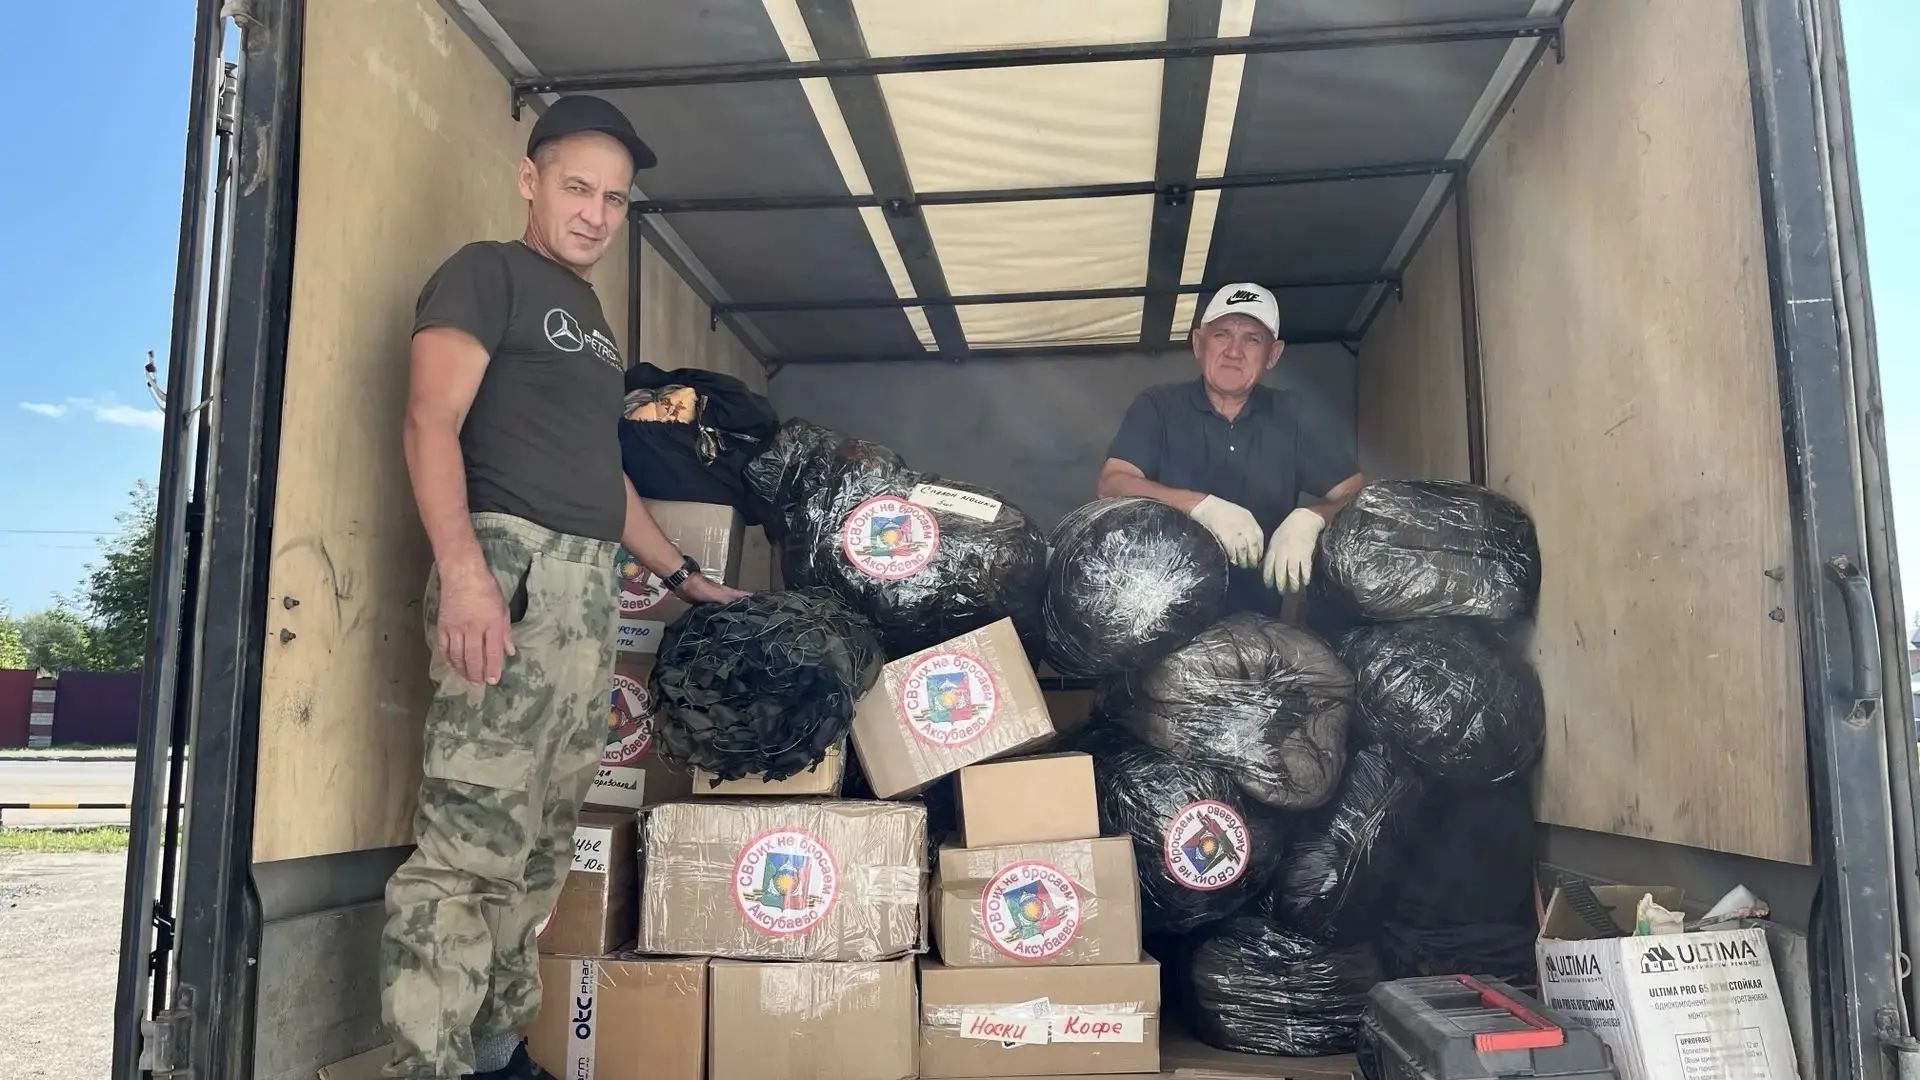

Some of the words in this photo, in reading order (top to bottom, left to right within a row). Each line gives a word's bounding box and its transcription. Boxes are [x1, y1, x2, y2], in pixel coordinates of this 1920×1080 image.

[1232, 289, 1260, 300] NIKE
[585, 333, 620, 361] PETRO
[880, 503, 895, 512] не
[898, 504, 932, 539] бросаем
[861, 554, 925, 574] Аксубаево
[619, 599, 651, 609] аево
[932, 658, 948, 669] не
[953, 656, 992, 700] бросаем
[602, 725, 652, 761] ксубаево
[921, 717, 986, 743] Аксубаево
[1170, 812, 1195, 864] бросаем
[1207, 805, 1245, 853] Аксубаево
[777, 836, 794, 847] не
[799, 837, 832, 895] бросаем
[1178, 865, 1192, 878] не
[1002, 873, 1019, 886] не
[1021, 867, 1074, 901] бросаем
[748, 903, 818, 929] Аксубаево
[1014, 919, 1075, 957] Аксубаево
[1677, 940, 1757, 963] ULTIMA
[581, 960, 589, 993] Phar
[1556, 954, 1601, 975] ULTIMA
[1649, 986, 1678, 998] ULTIMA
[1680, 984, 1697, 995] PRO
[1698, 983, 1709, 993] 65
[970, 1016, 1027, 1040] Носки
[1064, 1016, 1122, 1039] Кофе
